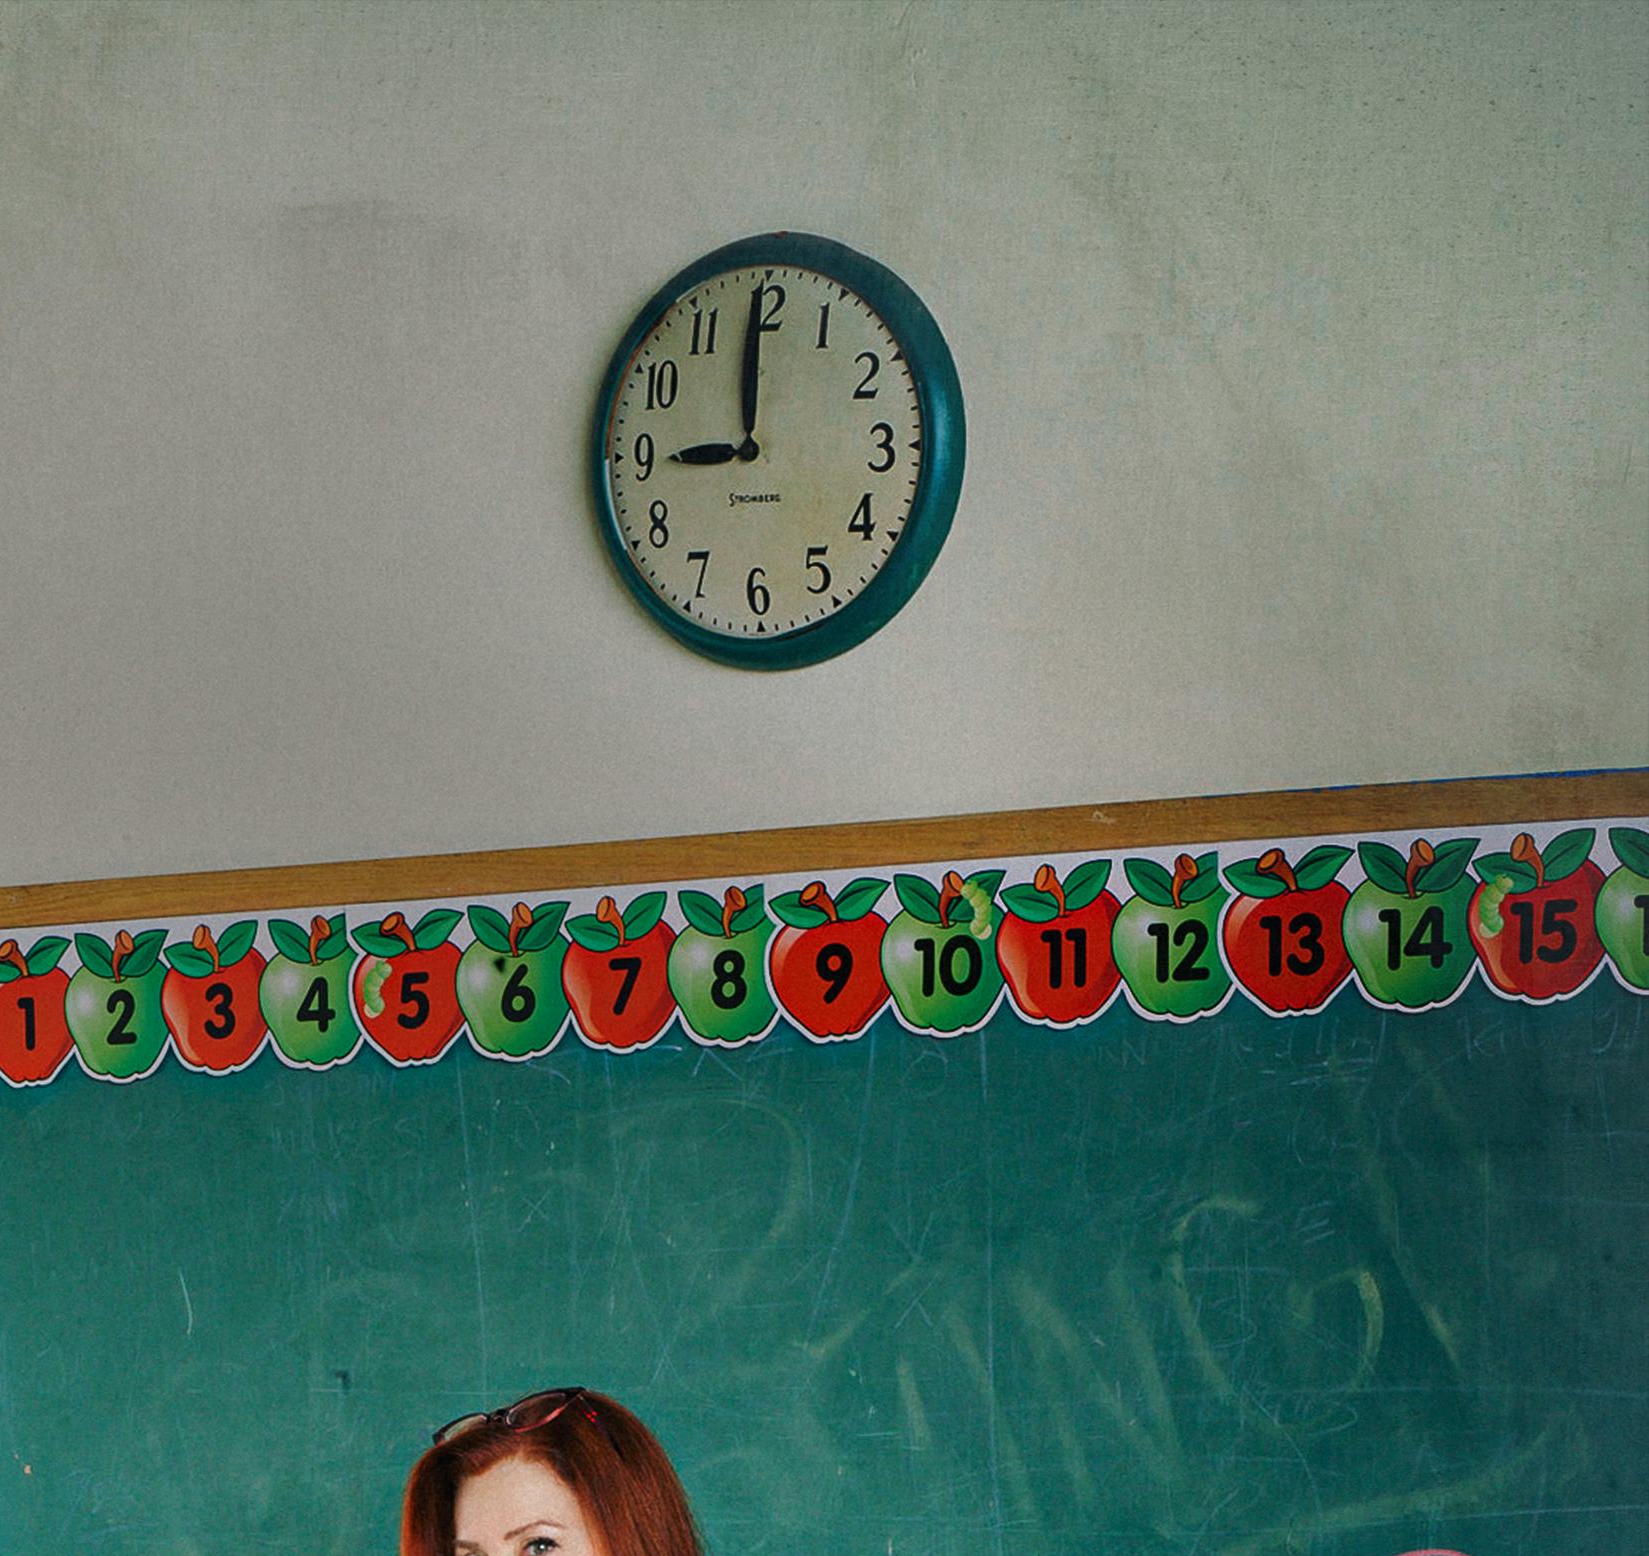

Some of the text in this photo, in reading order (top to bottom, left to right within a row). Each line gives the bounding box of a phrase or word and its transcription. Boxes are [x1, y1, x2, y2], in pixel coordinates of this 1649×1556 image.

[750, 280, 786, 332] 2
[815, 302, 831, 349] 1
[689, 307, 718, 356] 11
[646, 360, 678, 410] 10
[852, 352, 880, 400] 2
[634, 433, 654, 481] 9
[867, 422, 896, 473] 3
[649, 500, 669, 549] 8
[848, 492, 876, 541] 4
[686, 550, 710, 599] 7
[746, 567, 771, 615] 6
[805, 545, 832, 594] 5
[17, 894, 1649, 1052] 1 2 3 4 5 6 7 8 9 10 11 12 13 14 15 1
